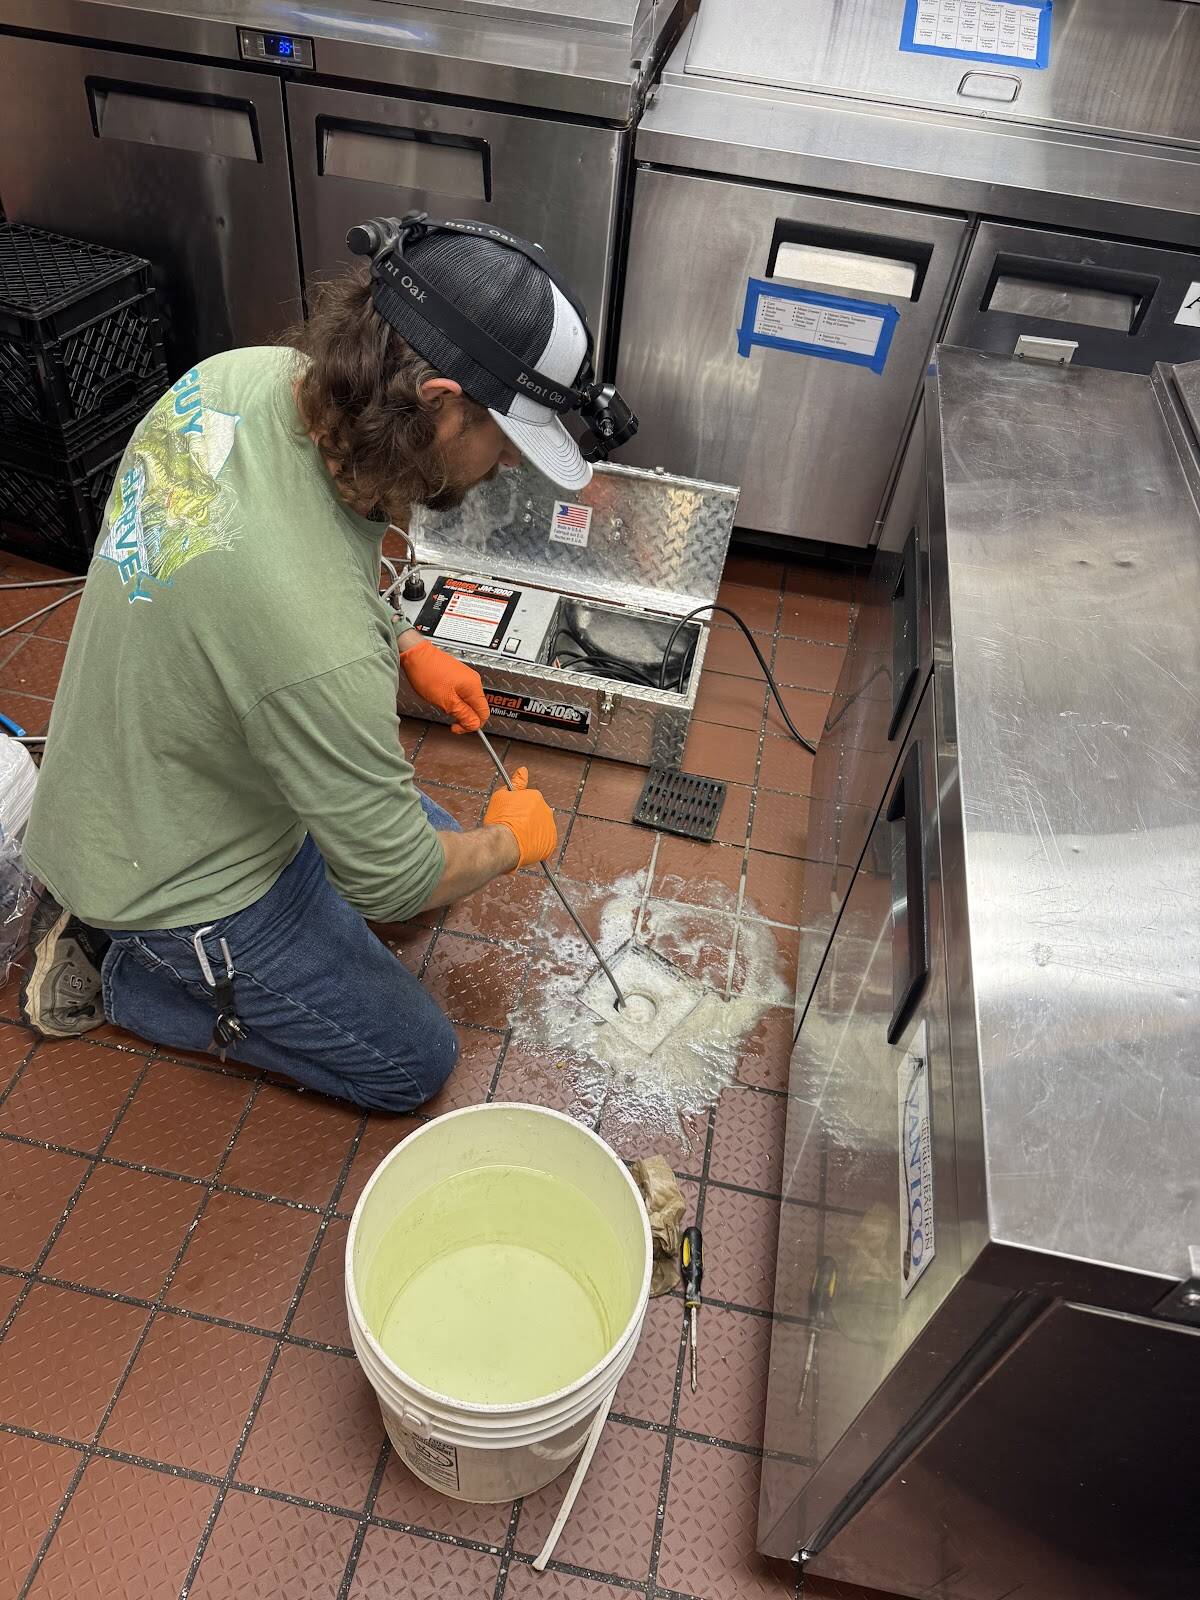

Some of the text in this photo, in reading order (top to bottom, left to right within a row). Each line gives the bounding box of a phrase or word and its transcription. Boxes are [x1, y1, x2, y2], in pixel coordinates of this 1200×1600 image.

[400, 275, 428, 304] Oak
[516, 372, 548, 397] Bent
[171, 368, 204, 435] GUY
[446, 579, 479, 591] General
[478, 584, 514, 598] JM-1000
[485, 693, 523, 709] neral
[490, 707, 519, 719] Mini-Jet
